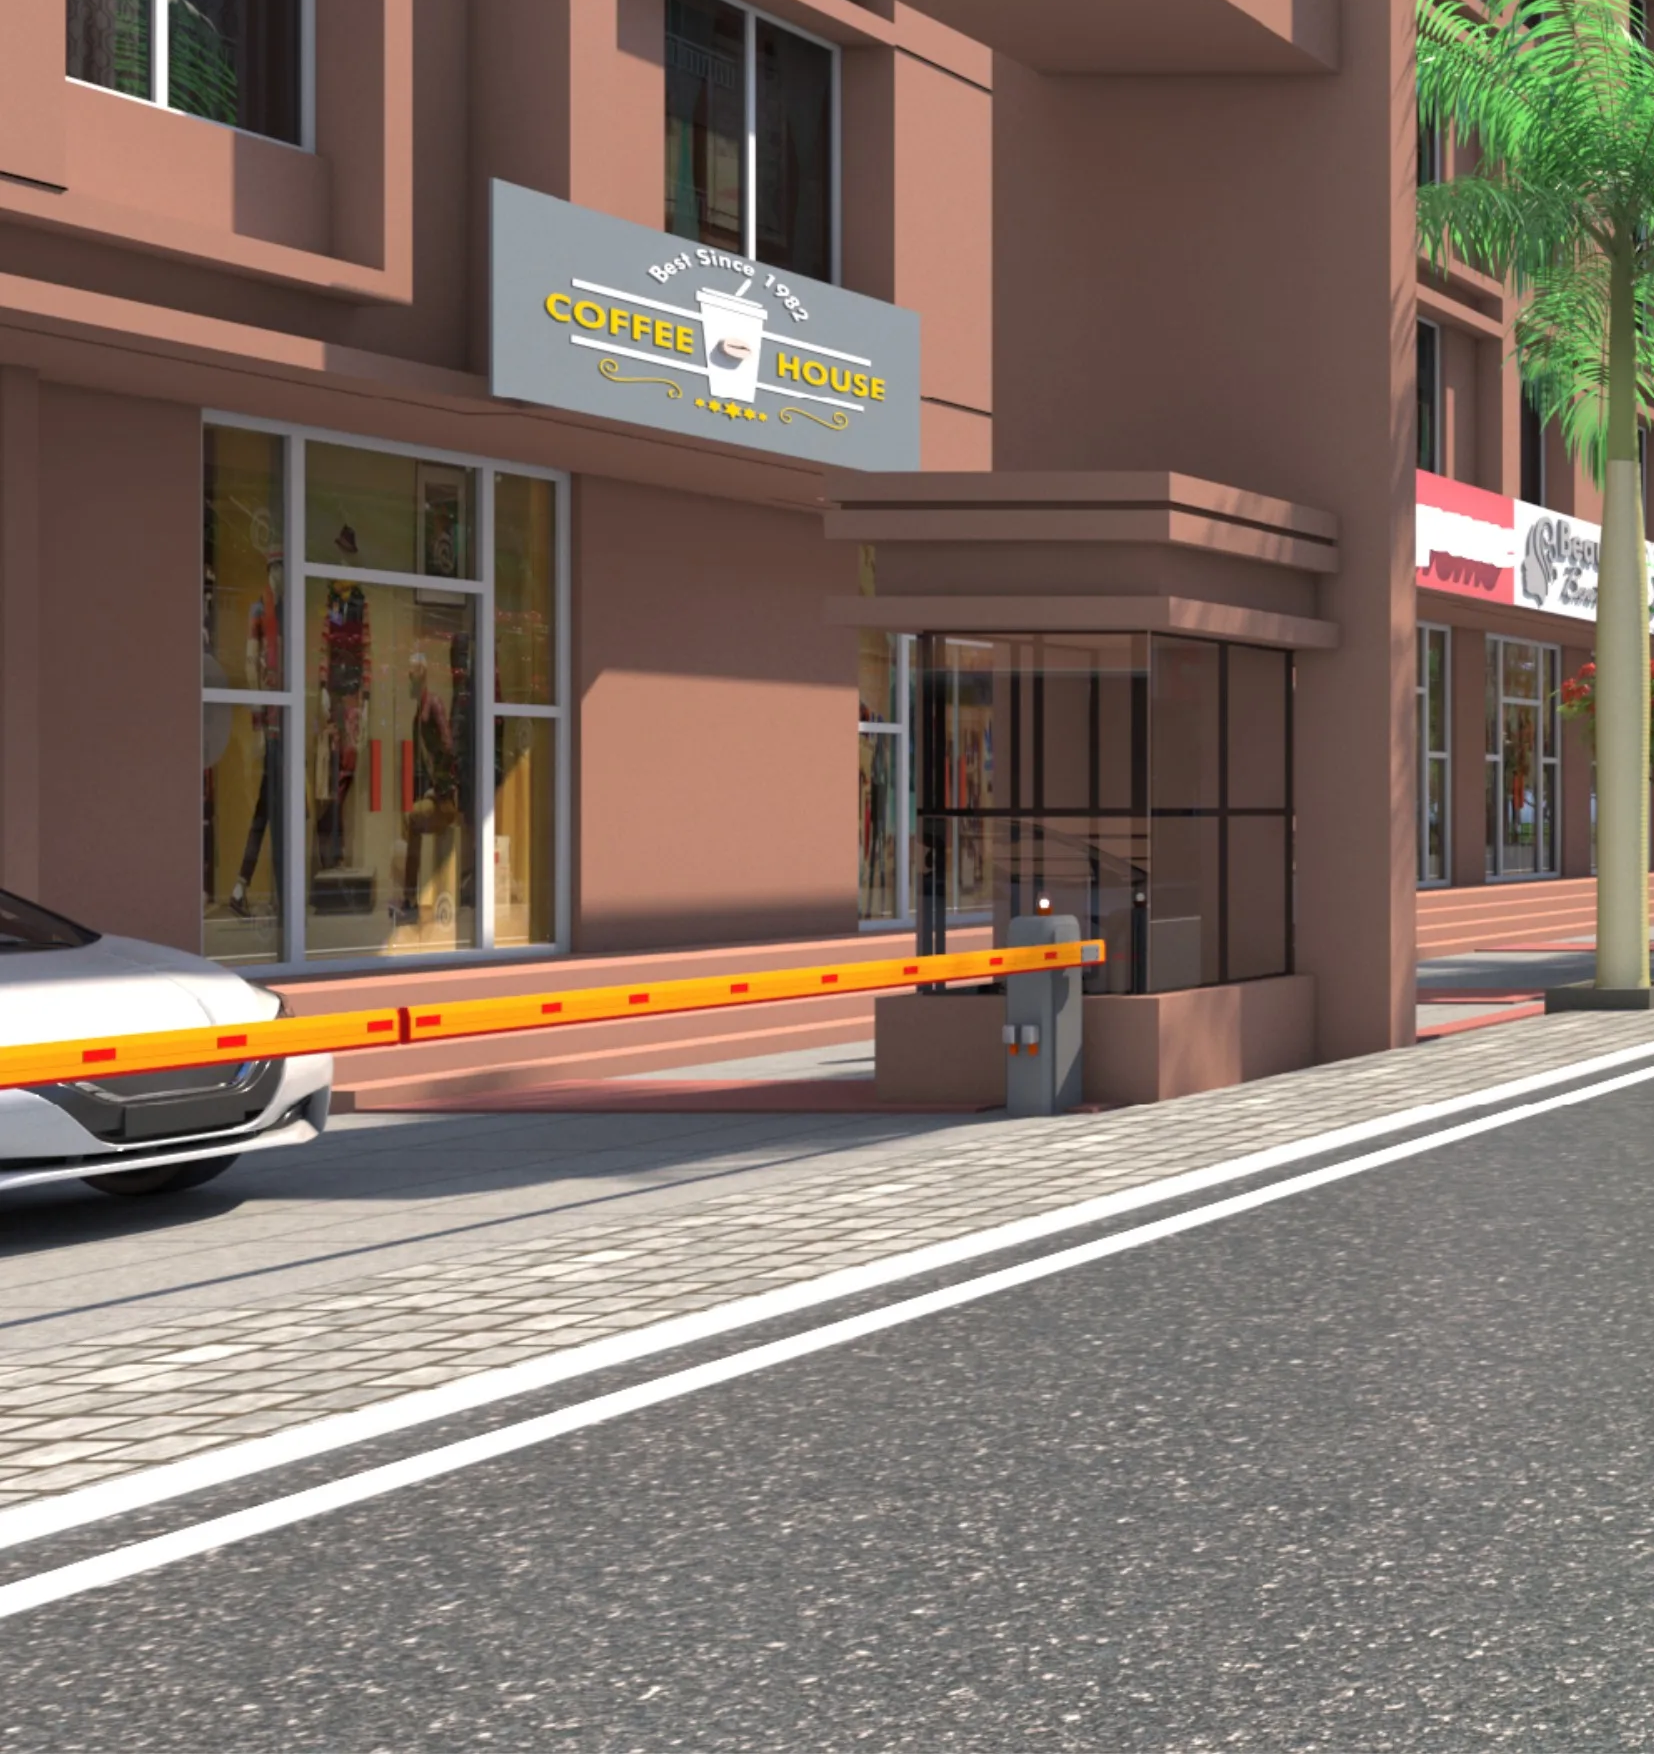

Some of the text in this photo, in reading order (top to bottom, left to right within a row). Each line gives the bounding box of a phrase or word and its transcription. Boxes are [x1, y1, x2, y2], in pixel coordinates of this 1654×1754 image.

[648, 249, 809, 323] Best Since 1982
[544, 292, 887, 401] COFFEE HOUSE
[1556, 519, 1599, 572] Bea
